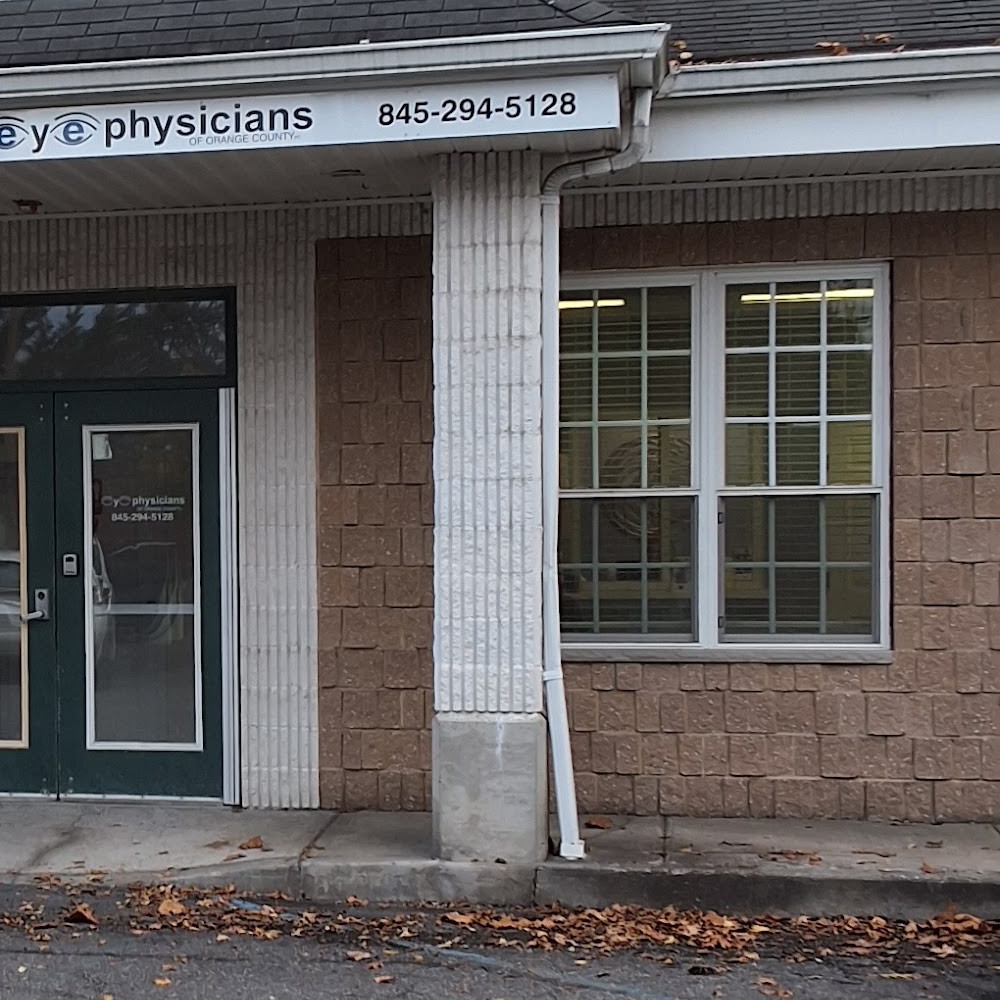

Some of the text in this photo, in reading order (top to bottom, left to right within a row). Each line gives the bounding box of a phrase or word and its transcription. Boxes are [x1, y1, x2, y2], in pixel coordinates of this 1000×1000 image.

[378, 92, 576, 126] 845-294-5128
[105, 103, 313, 147] physicians
[189, 136, 203, 146] OF
[205, 134, 249, 144] ORANGE
[251, 131, 295, 143] COUNTY
[132, 495, 185, 507] physicians
[111, 513, 174, 522] 845-294-5128
